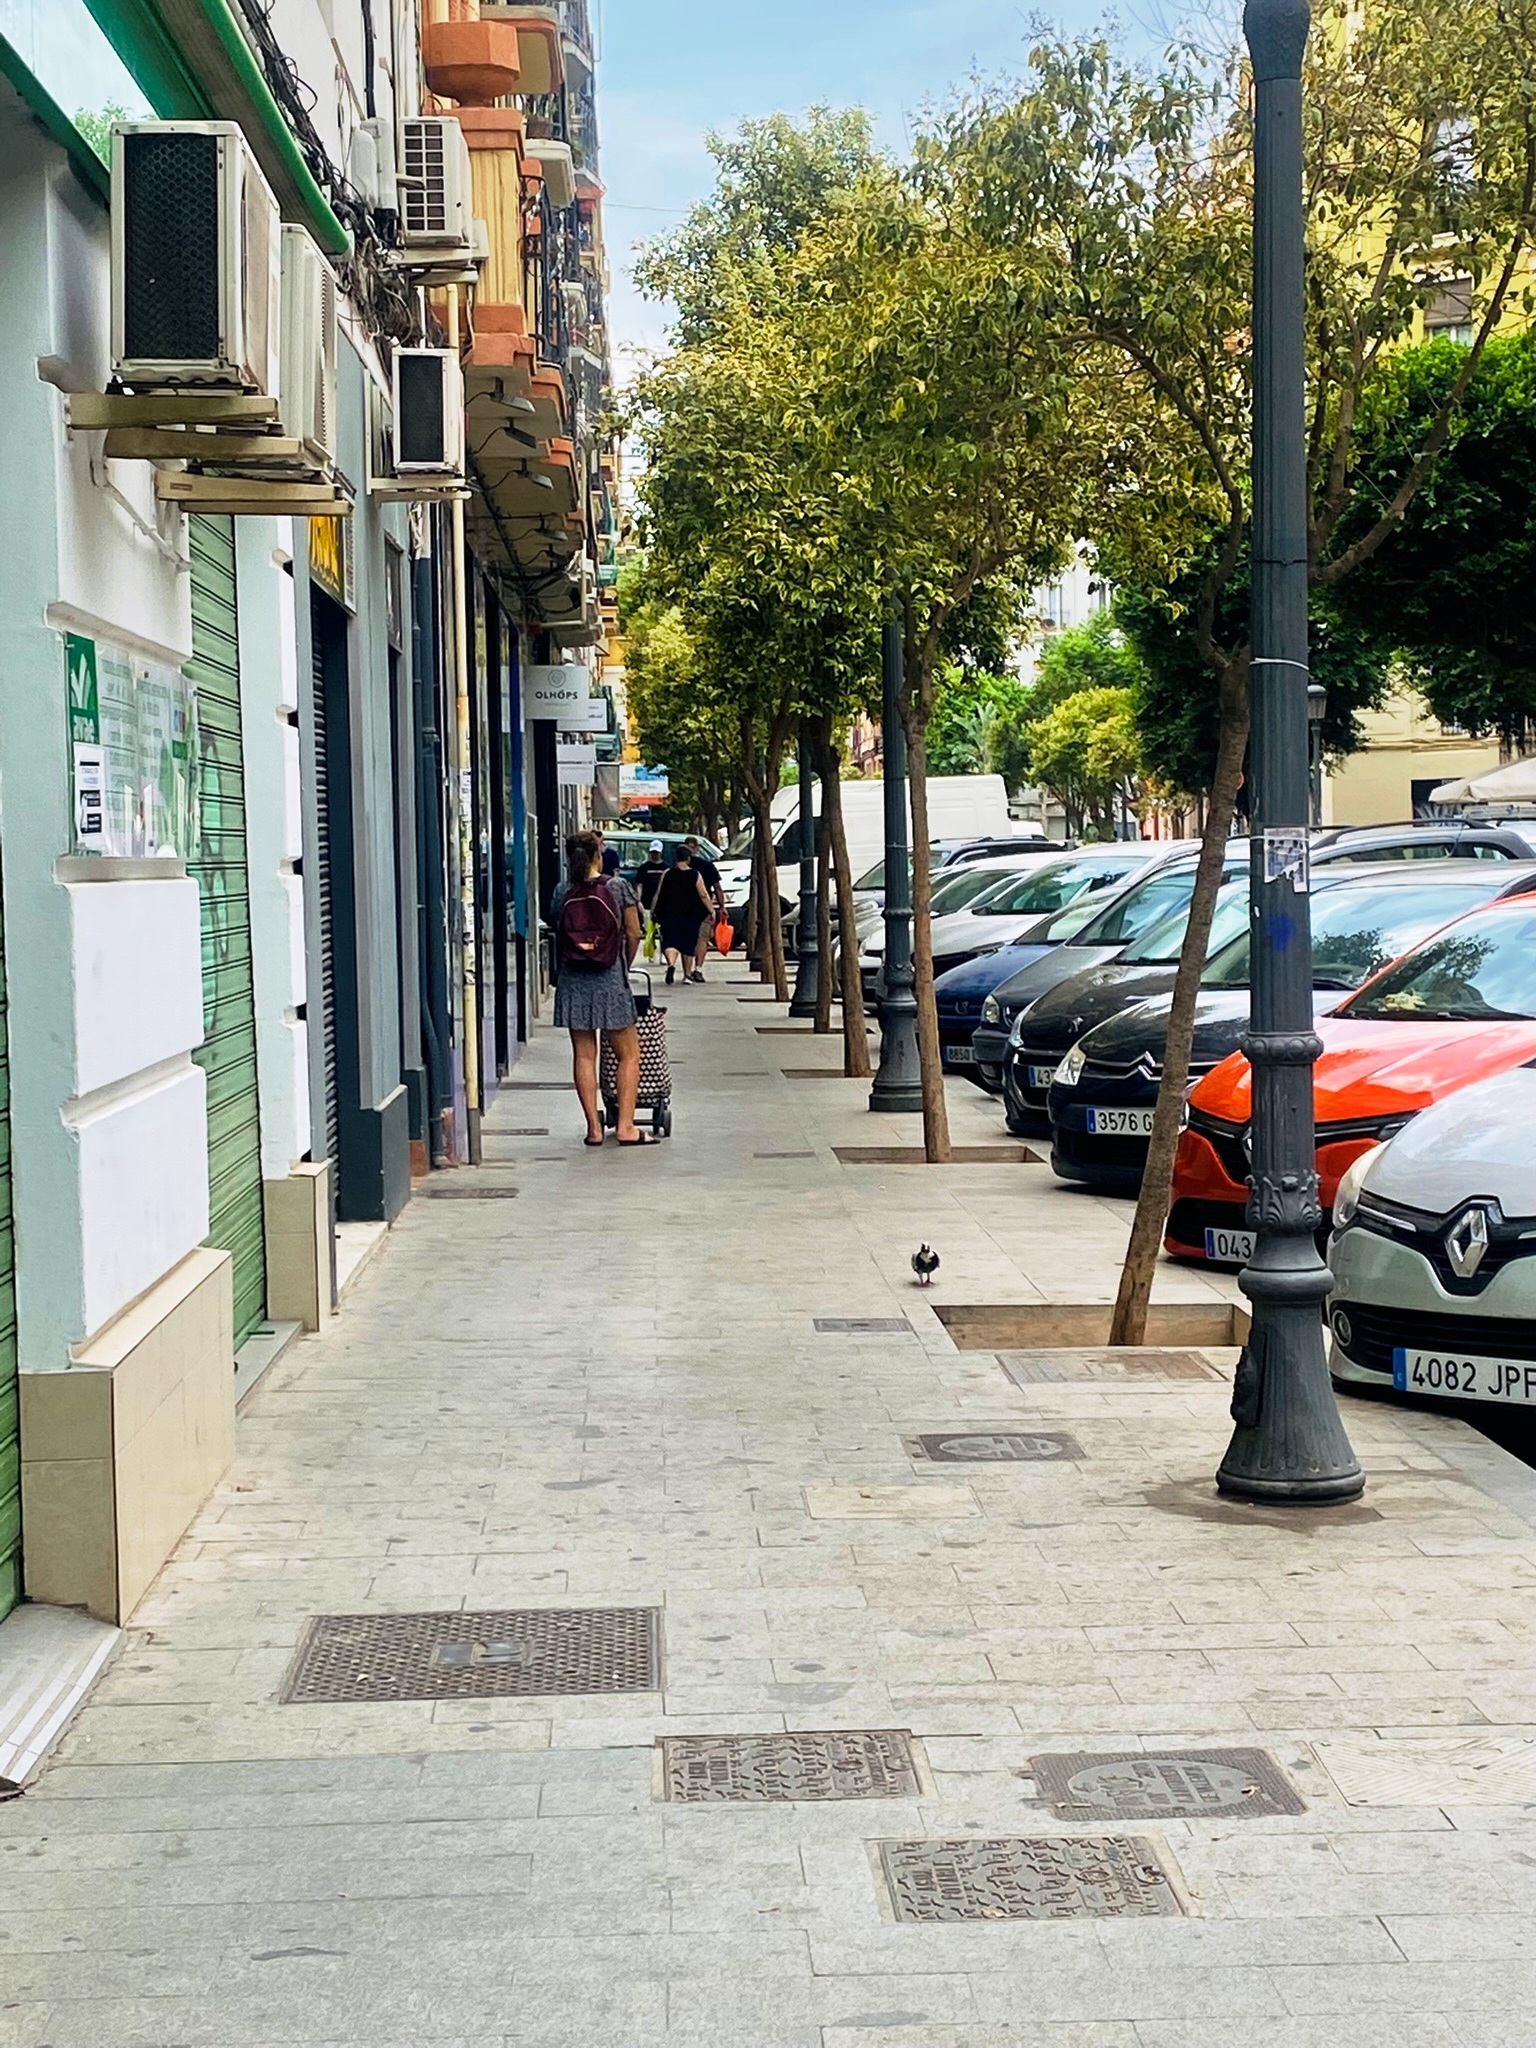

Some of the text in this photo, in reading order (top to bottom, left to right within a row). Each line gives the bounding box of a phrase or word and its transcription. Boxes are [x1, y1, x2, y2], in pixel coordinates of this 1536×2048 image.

[1098, 1112, 1156, 1132] 3576 G
[1217, 1233, 1252, 1259] 043
[1412, 1356, 1536, 1398] 4082 JPF
